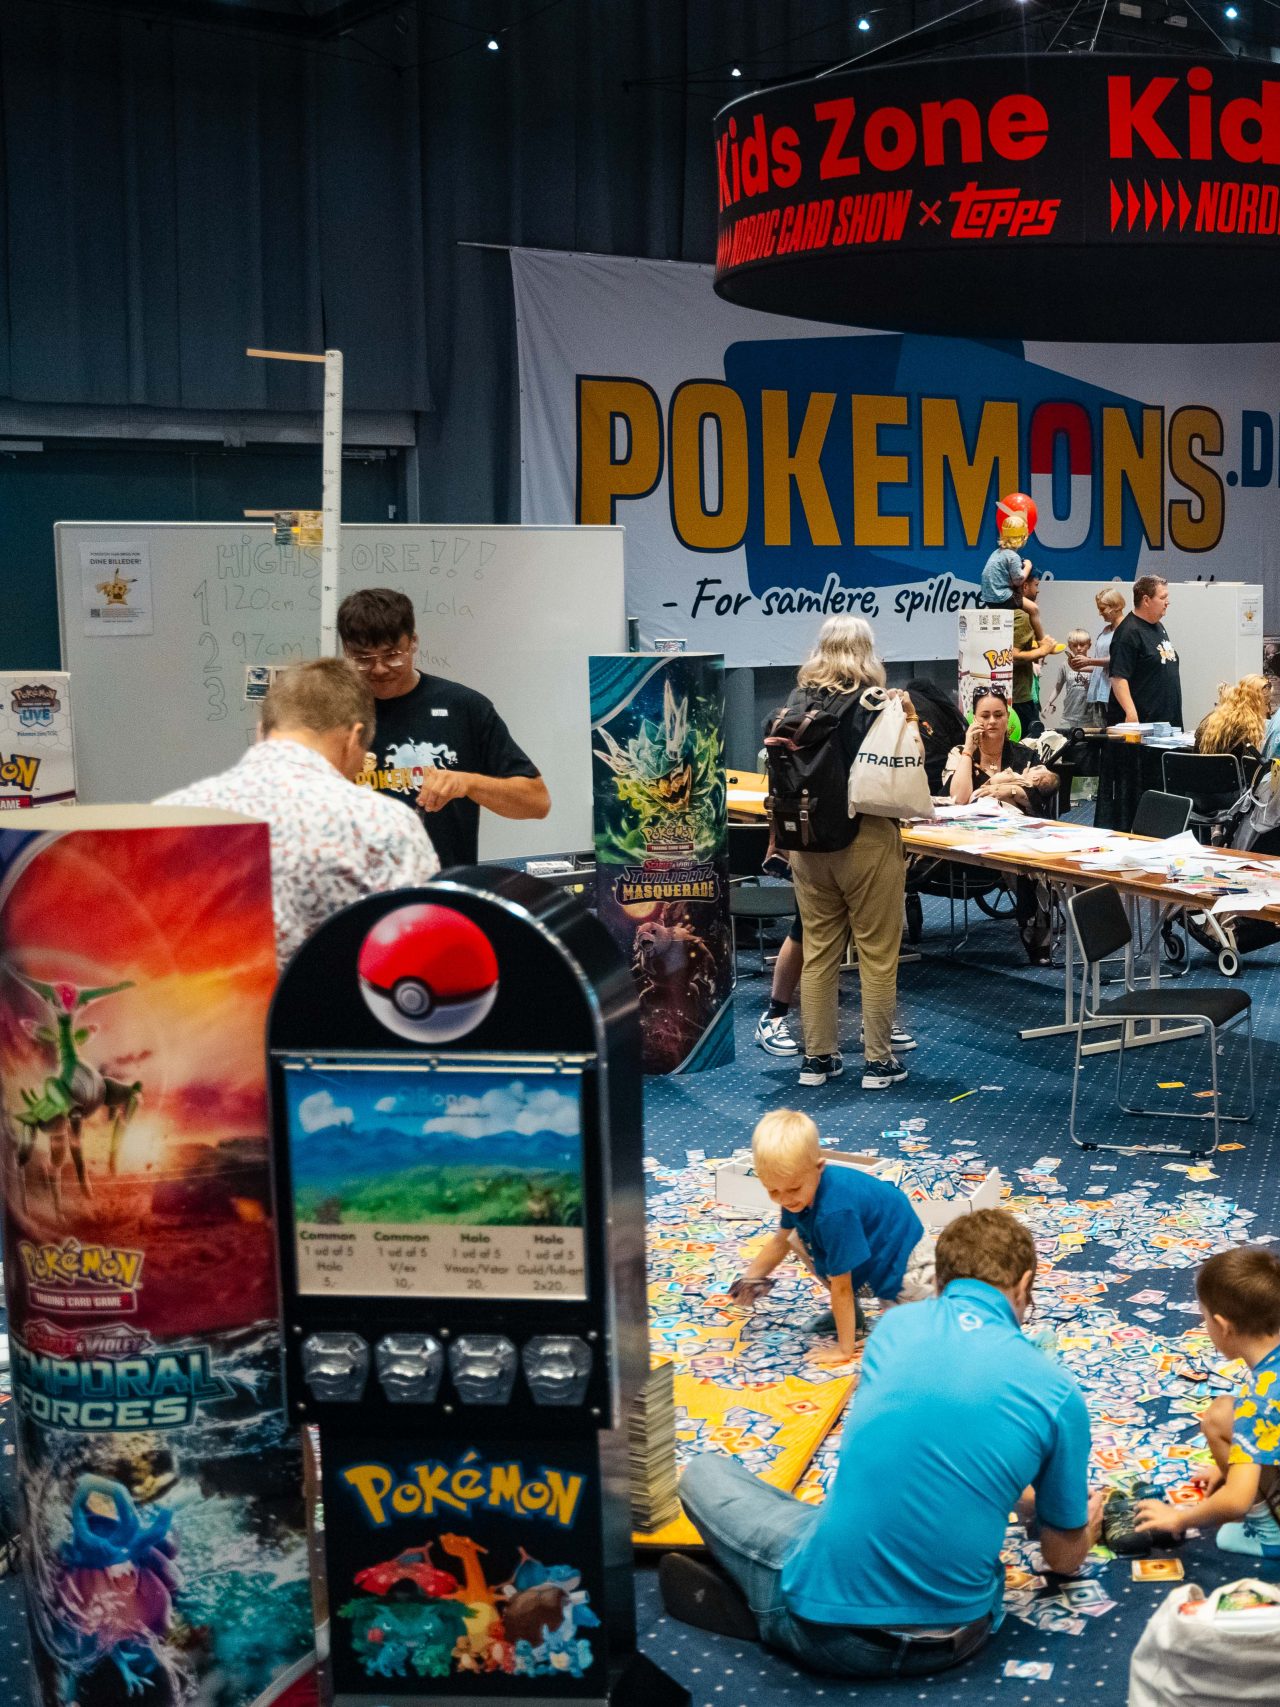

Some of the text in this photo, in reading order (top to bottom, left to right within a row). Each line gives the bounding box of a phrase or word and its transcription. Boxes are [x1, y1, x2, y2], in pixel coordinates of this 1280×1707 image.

[717, 91, 1049, 214] Kids Zone
[729, 209, 780, 268] NORDIC
[777, 200, 834, 255] CARD
[833, 189, 912, 247] SHOW
[691, 577, 753, 618] For
[761, 578, 880, 618] samlere,
[199, 632, 222, 674] 2
[203, 676, 228, 722] 3
[22, 709, 50, 720] LIVE
[630, 866, 711, 884] TWILIGHT
[622, 880, 715, 902] MASQUERADE
[300, 1231, 356, 1241] Common
[374, 1232, 430, 1242] Common
[460, 1232, 490, 1244] Holo
[534, 1234, 564, 1244] Holo
[347, 1246, 353, 1257] 5
[422, 1247, 427, 1258] 5
[495, 1248, 501, 1258] 5
[568, 1249, 574, 1260] 5
[317, 1262, 343, 1272] Holo
[67, 1295, 92, 1307] CARD
[94, 1296, 122, 1307] GAME
[21, 1388, 188, 1428] FORCES
